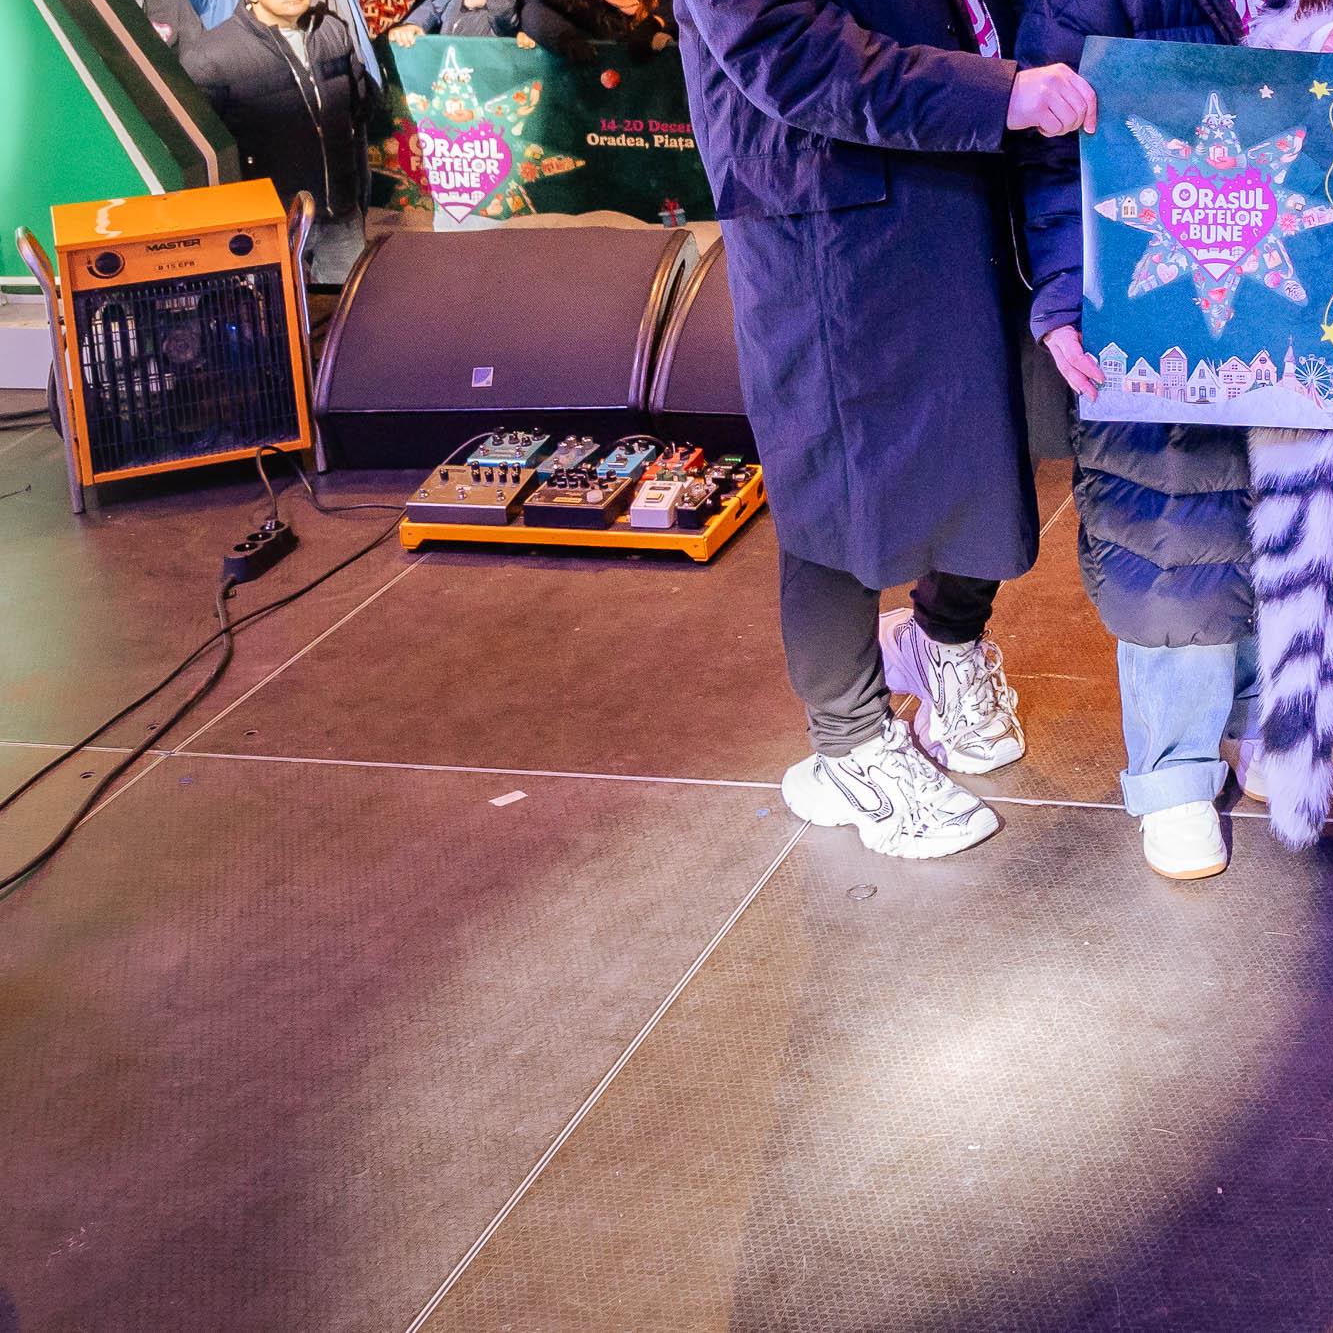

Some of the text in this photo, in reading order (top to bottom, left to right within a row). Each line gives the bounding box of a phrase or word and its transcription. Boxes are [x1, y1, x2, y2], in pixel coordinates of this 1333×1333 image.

[586, 133, 650, 149] Oradea,
[410, 156, 500, 175] FAPTELOR
[428, 170, 481, 189] BUNE
[1171, 208, 1263, 227] FAPTELOR
[1189, 223, 1243, 244] BUNE
[145, 238, 201, 252] MASTER
